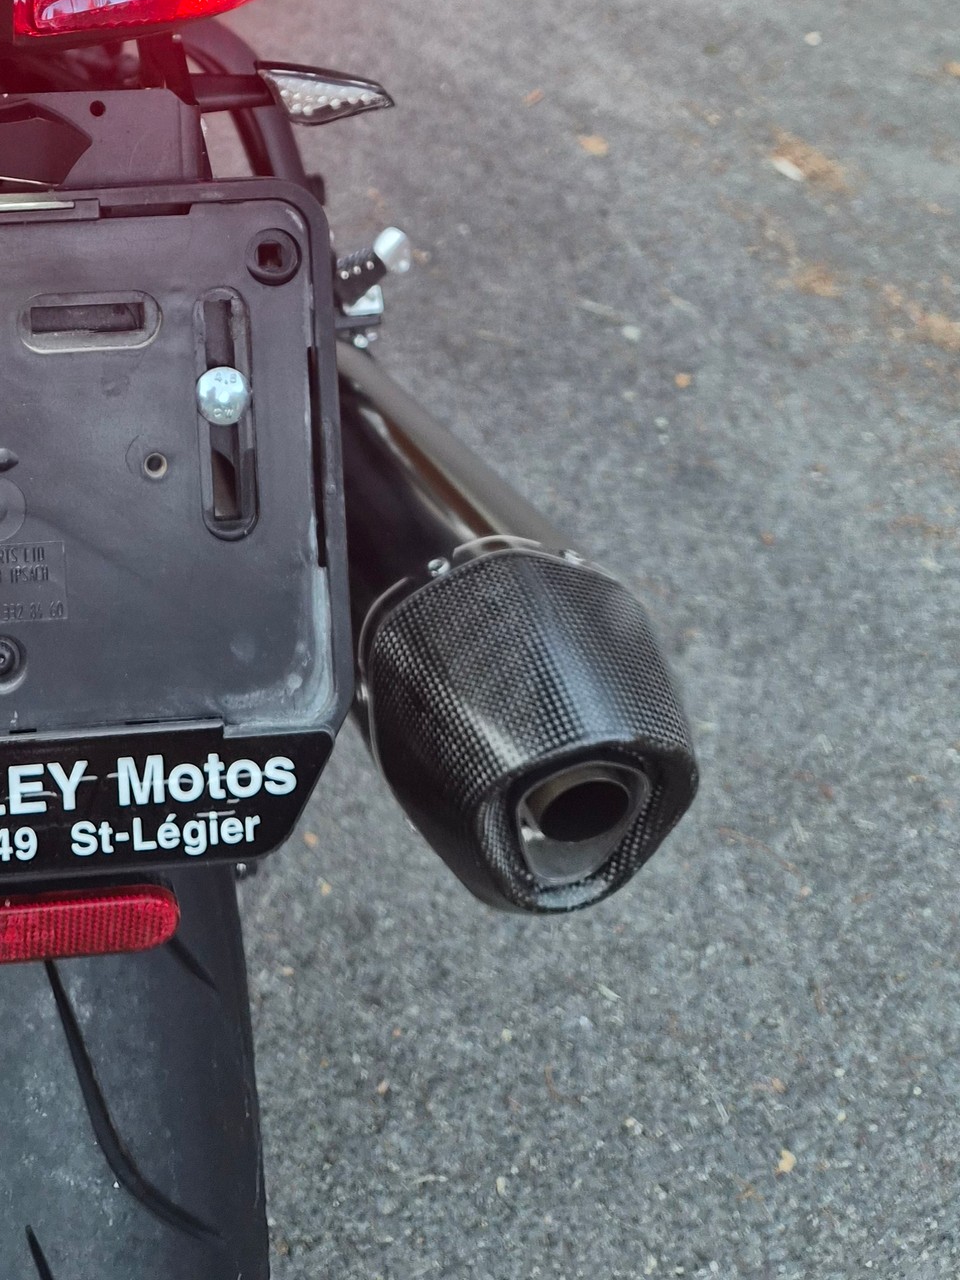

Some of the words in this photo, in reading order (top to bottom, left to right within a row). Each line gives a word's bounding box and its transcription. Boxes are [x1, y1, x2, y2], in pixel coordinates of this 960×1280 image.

[23, 545, 46, 563] LTD
[9, 564, 50, 584] IPSACH
[116, 753, 298, 807] Motos
[70, 810, 262, 856] St-Légier
